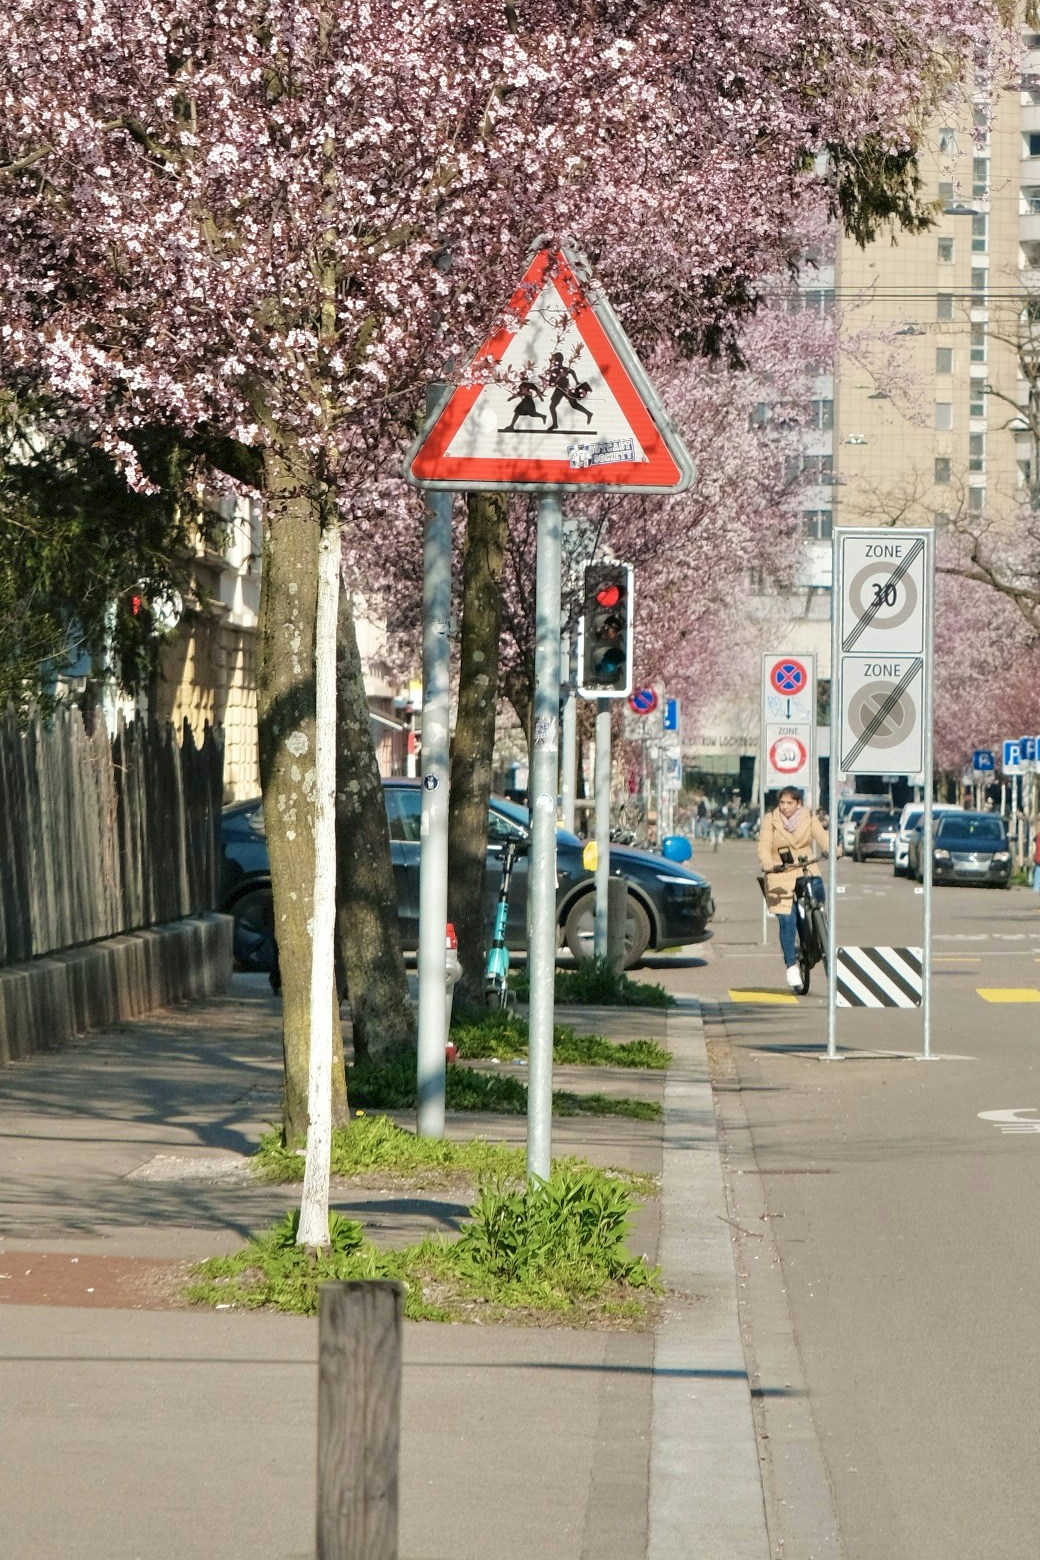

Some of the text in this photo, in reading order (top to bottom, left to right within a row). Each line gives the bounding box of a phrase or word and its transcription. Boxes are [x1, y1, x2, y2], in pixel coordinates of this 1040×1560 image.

[588, 441, 631, 454] OUTCAST
[593, 451, 632, 463] SOCIETY
[865, 545, 902, 558] ZONE
[871, 583, 897, 607] 30
[864, 664, 901, 677] ZONE
[778, 727, 798, 735] ZONE
